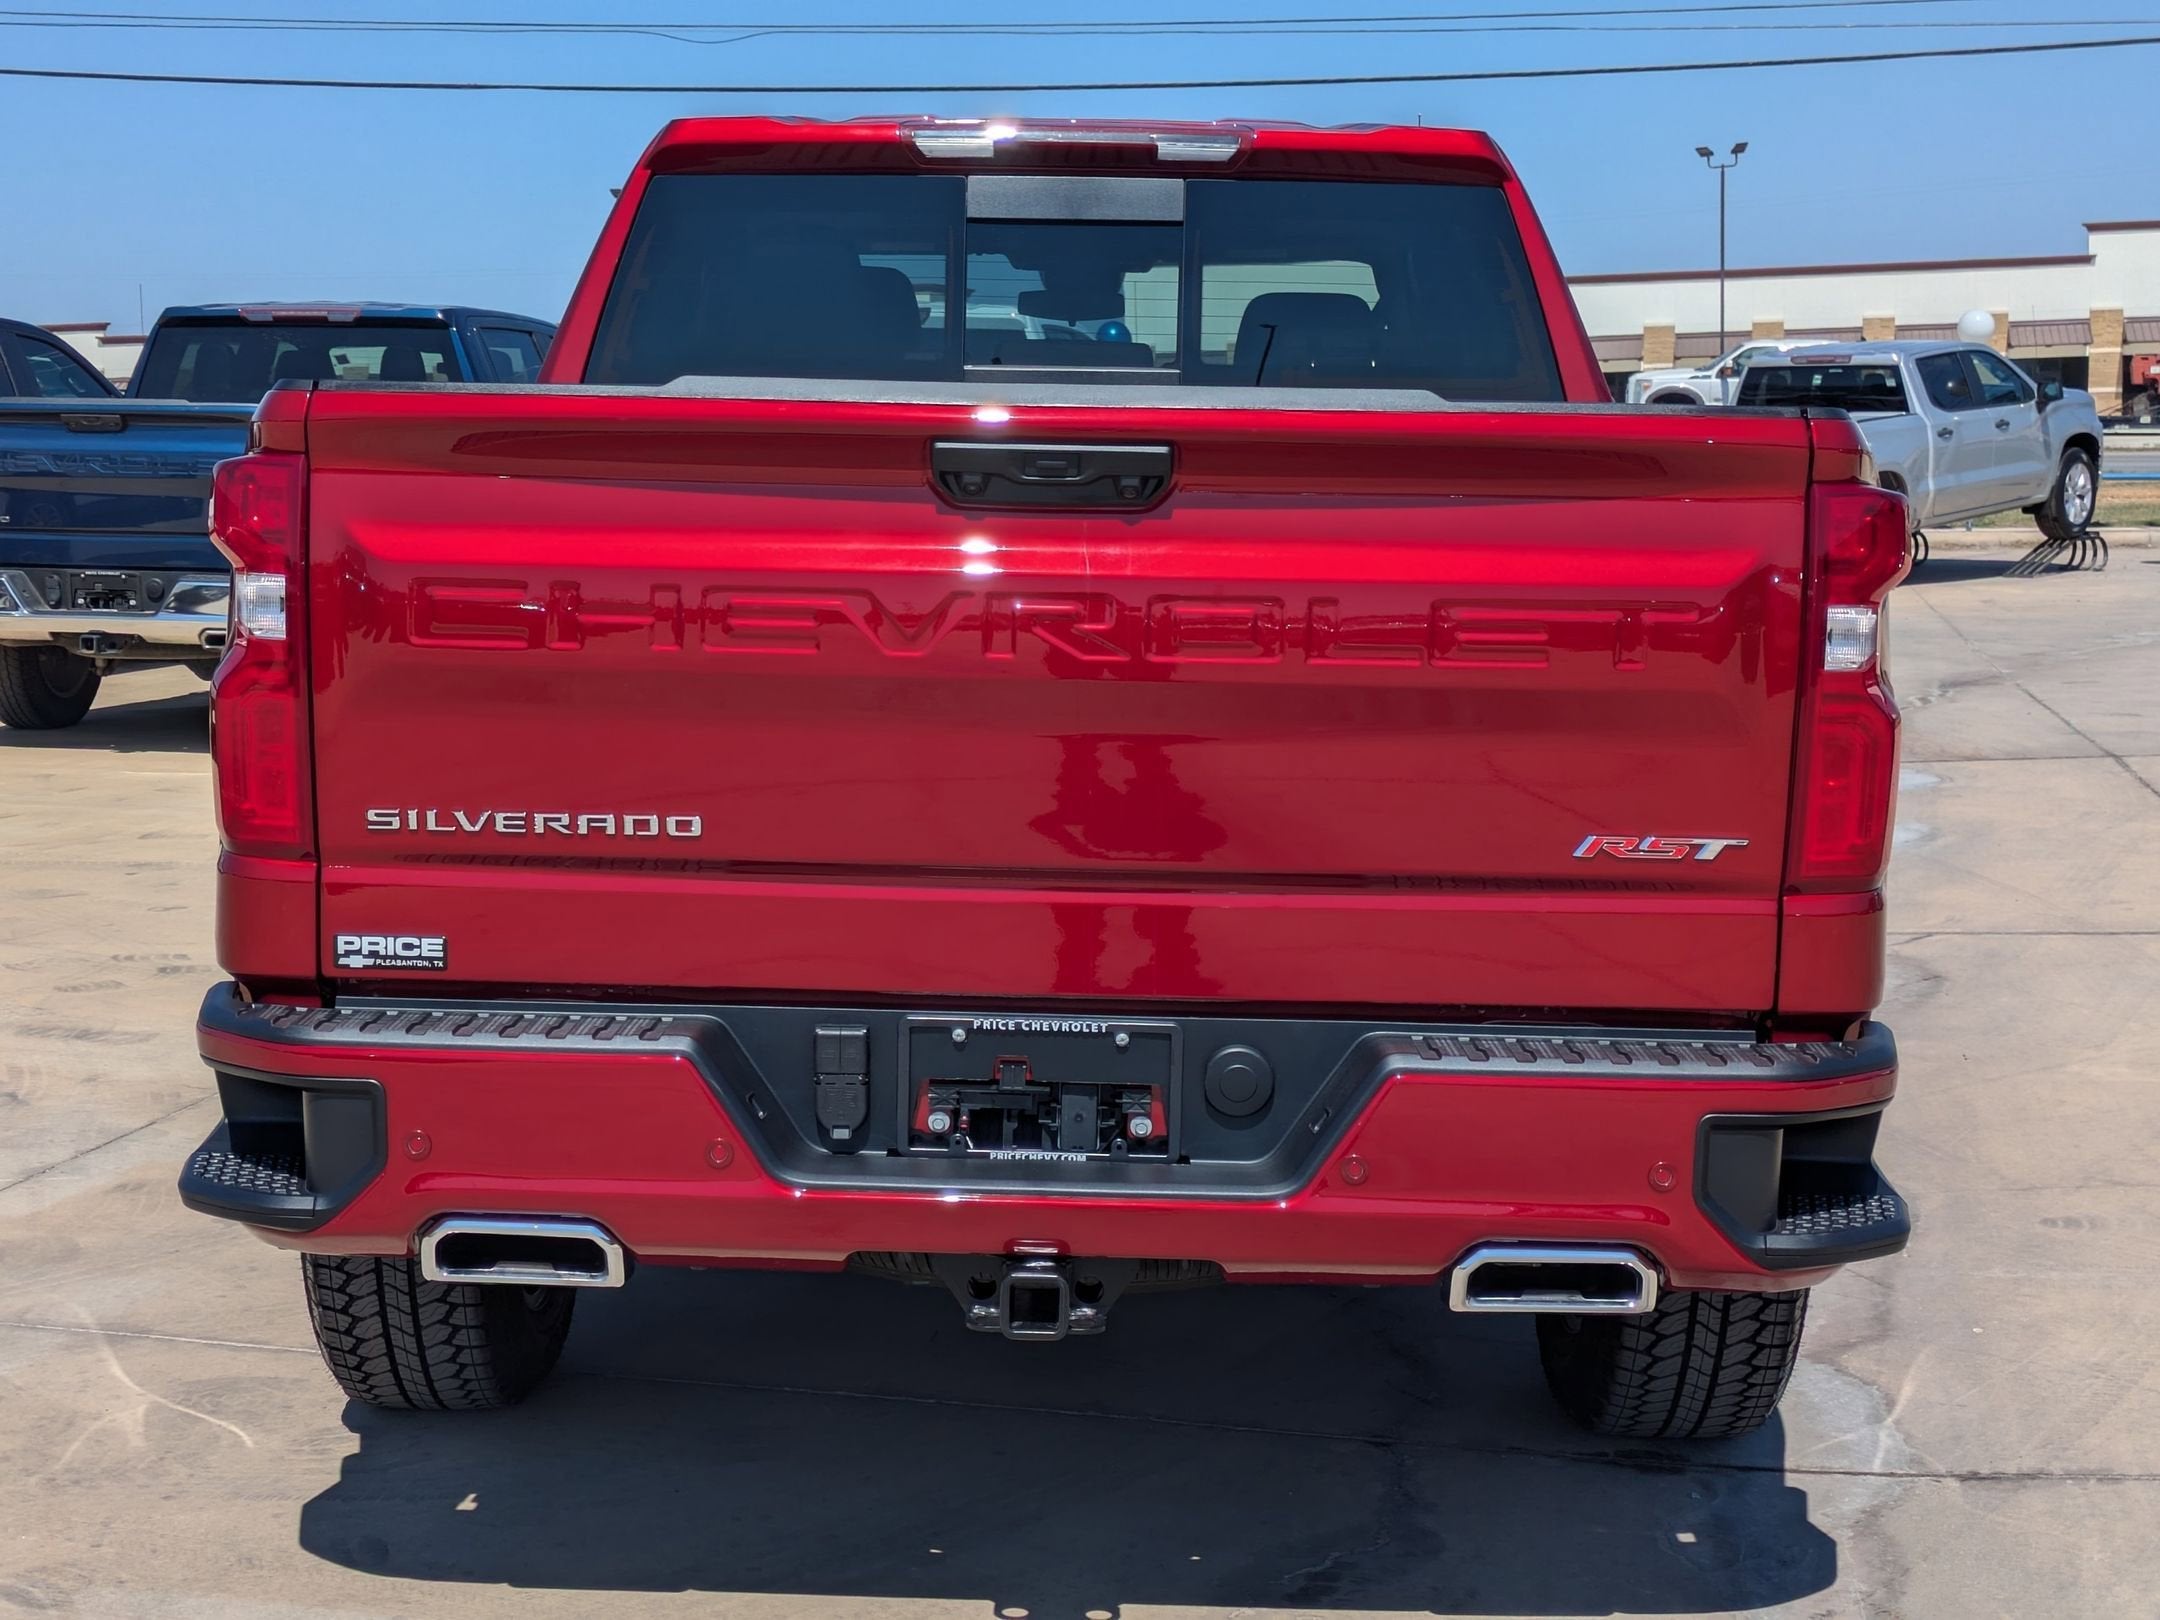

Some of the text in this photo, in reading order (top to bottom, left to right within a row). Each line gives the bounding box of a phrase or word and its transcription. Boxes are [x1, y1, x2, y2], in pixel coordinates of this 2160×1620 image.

[407, 577, 1699, 672] CHEVROLET
[366, 808, 702, 837] SILVERADO
[1572, 835, 1750, 861] RST
[337, 935, 444, 957] PRICE
[375, 958, 444, 968] PLEASANTON, TX
[973, 1019, 1109, 1033] PRICE CHEVROLET
[989, 1151, 1087, 1162] PRICECHEVYCOM
